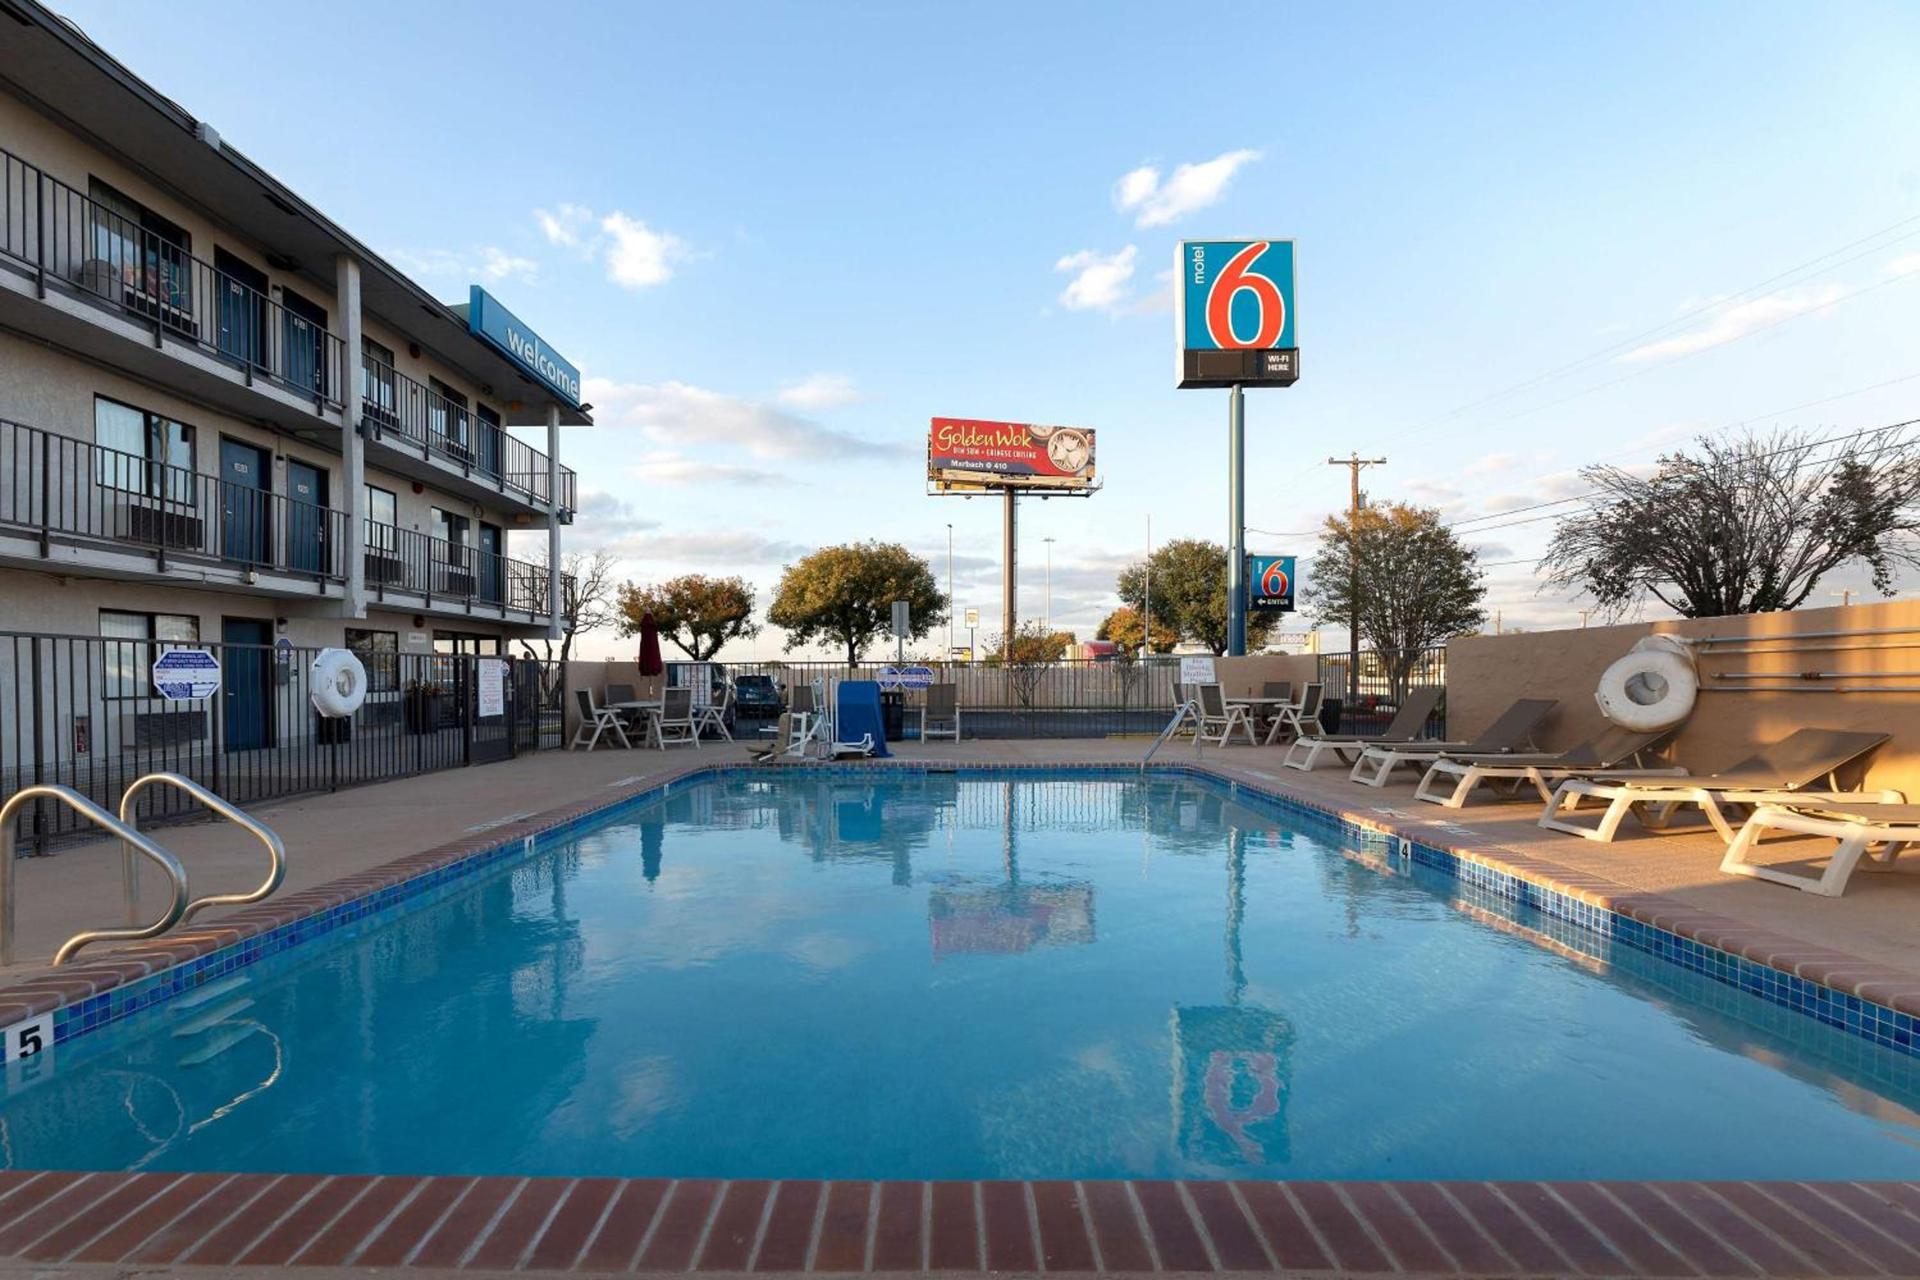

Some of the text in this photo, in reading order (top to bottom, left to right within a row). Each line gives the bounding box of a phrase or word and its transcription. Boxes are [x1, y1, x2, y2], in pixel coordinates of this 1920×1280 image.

[1192, 246, 1204, 284] motel
[1205, 240, 1286, 349] 6
[506, 327, 579, 399] welcome
[1267, 355, 1289, 363] WI-FI
[935, 425, 1032, 451] Golden Wok
[950, 459, 984, 469] Marbach
[994, 462, 1008, 470] 410
[1261, 560, 1289, 597] 6
[1401, 843, 1409, 859] 4
[19, 1024, 43, 1058] 5
